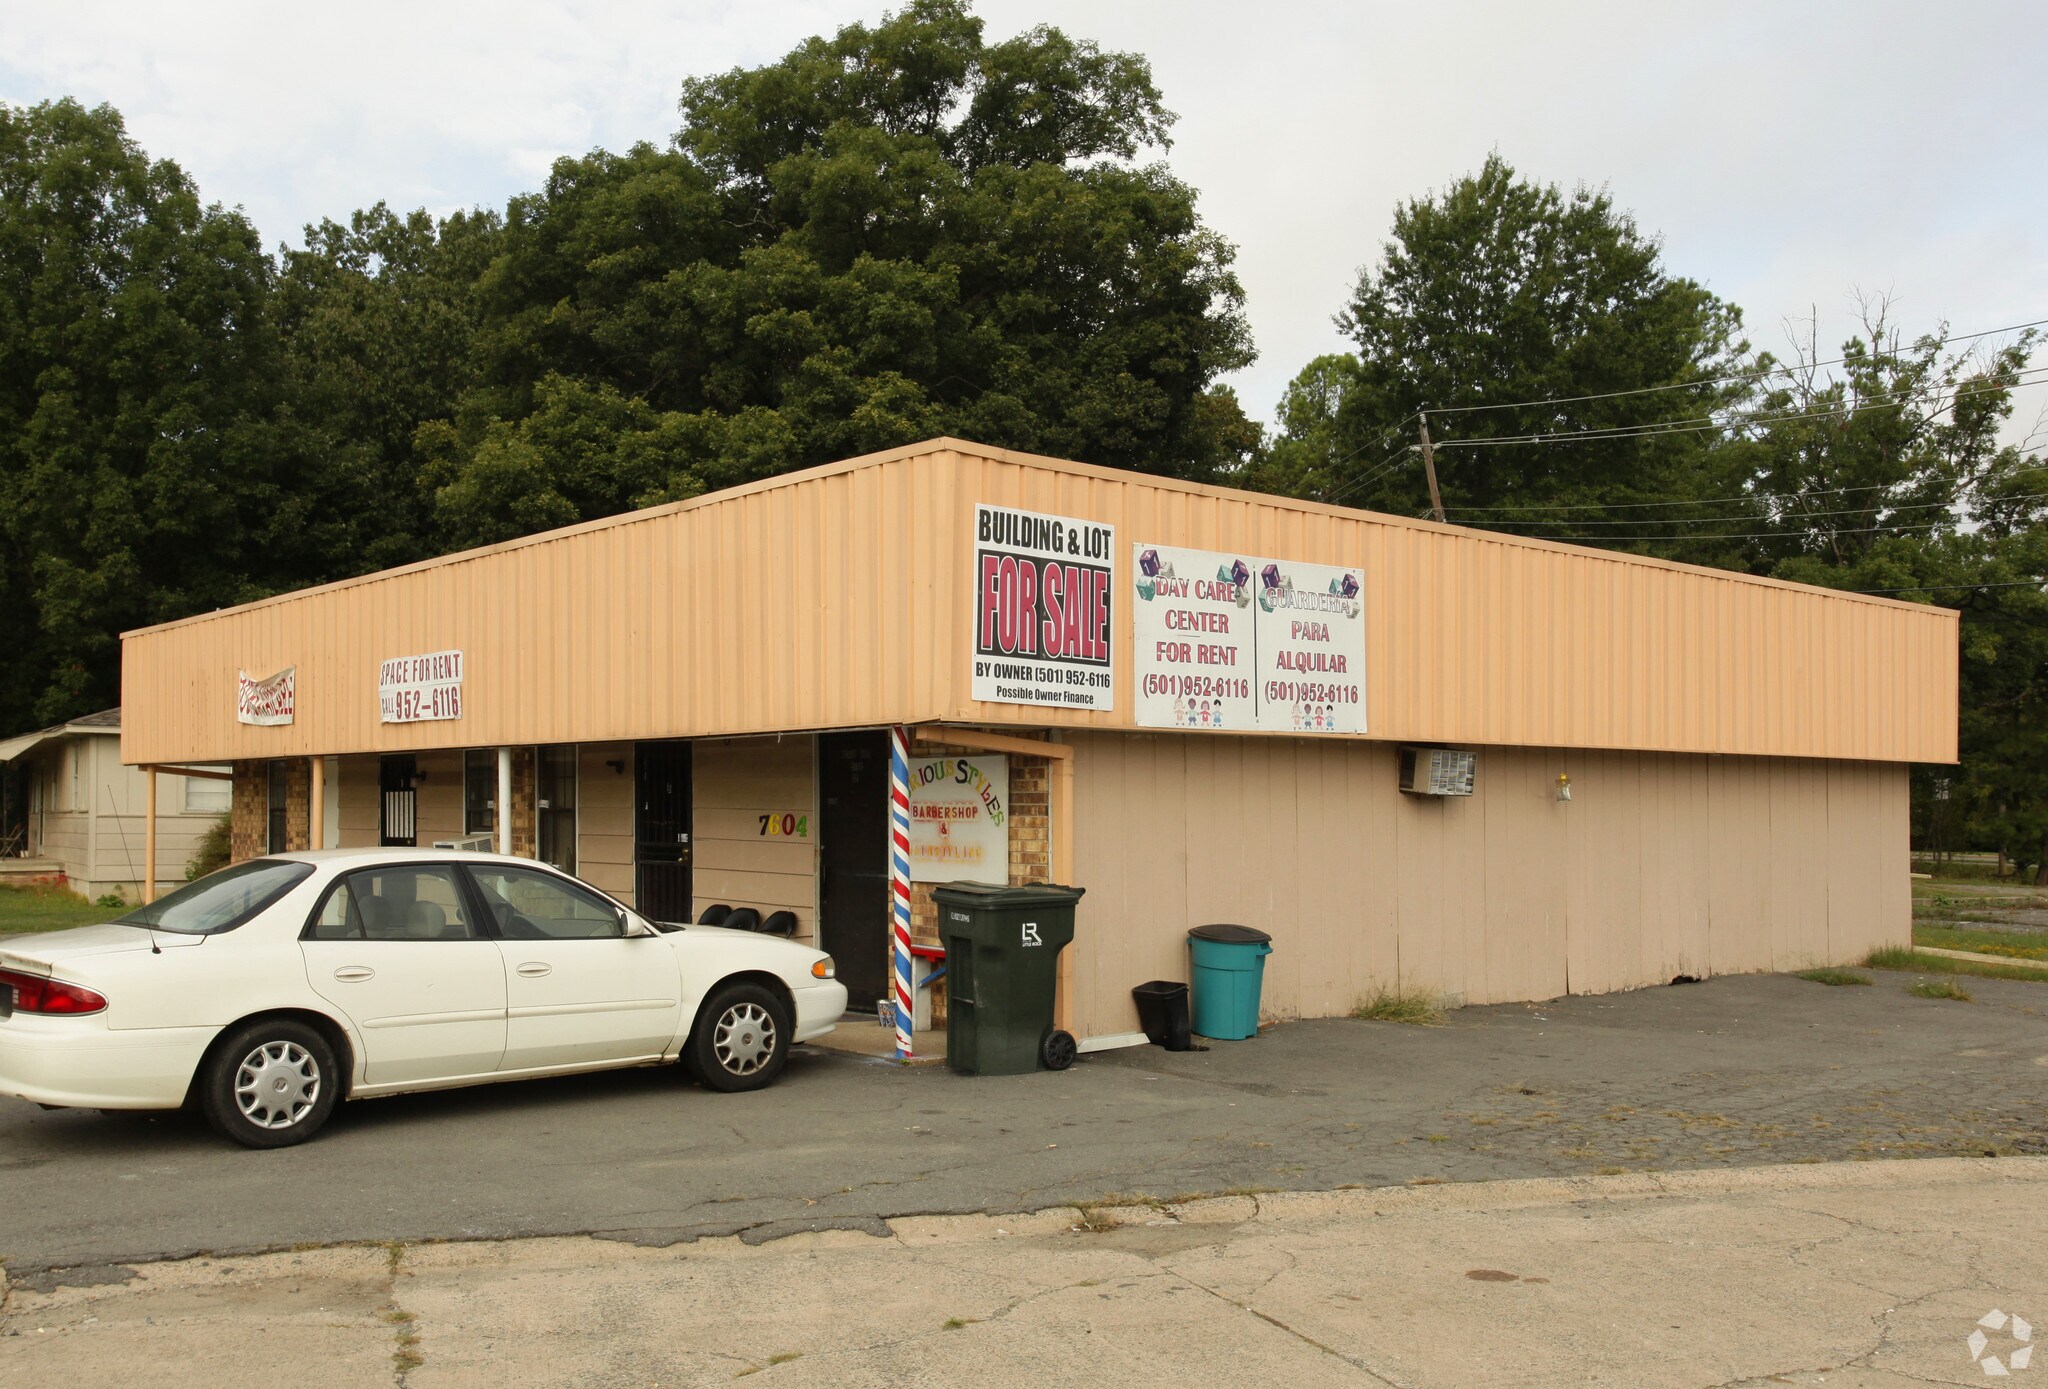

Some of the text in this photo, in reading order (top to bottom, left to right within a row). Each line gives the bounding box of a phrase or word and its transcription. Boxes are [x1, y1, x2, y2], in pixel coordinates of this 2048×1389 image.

[979, 509, 1111, 560] BUILDING & LOT
[1156, 576, 1236, 602] DAY CARE
[981, 554, 1107, 662] FOR SALE
[1165, 609, 1229, 633] CENTER
[1291, 621, 1330, 642] PARA
[1156, 641, 1237, 666] FOR RENT
[1276, 650, 1347, 674] ALQUILAR
[380, 654, 460, 686] SPACE FOR RENT
[976, 662, 1110, 688] BY OWNER (501) 952-6116
[996, 685, 1094, 704] Possible Owner Finance
[1143, 673, 1249, 699] (501)952-6116
[1264, 680, 1358, 704] (501)952-6116
[396, 686, 459, 720] 952-6116
[903, 759, 1004, 827] RIOUS STYLES
[913, 805, 978, 819] BARBERSHOP
[759, 813, 807, 837] 7604
[941, 823, 947, 835] &
[909, 845, 983, 859] AIRSTYLING
